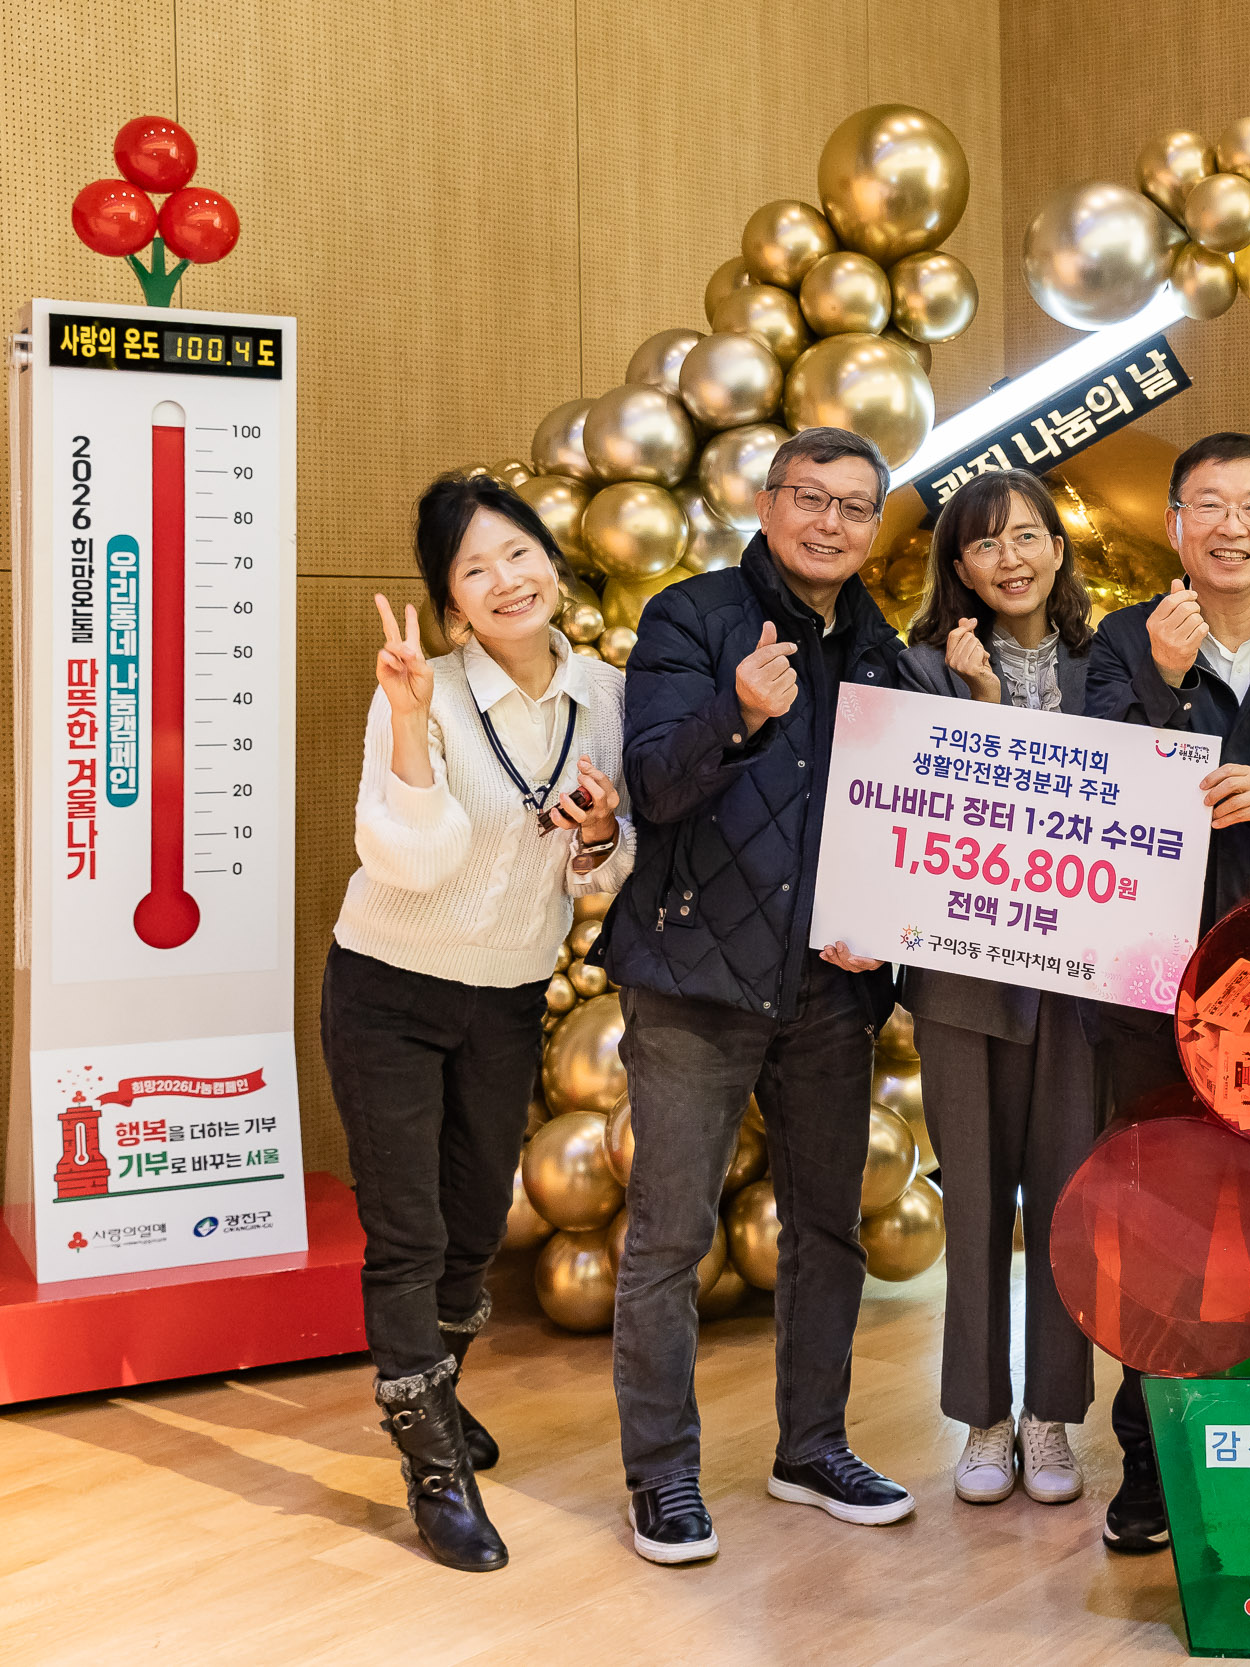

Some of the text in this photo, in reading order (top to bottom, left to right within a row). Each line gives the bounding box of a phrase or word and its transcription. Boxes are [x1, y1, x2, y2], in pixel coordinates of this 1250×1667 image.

[60, 324, 275, 367] 사랑의 온도 100.4 도
[1011, 374, 1134, 465] 나눔의
[1125, 349, 1177, 400] 날
[232, 425, 261, 439] 100
[233, 467, 253, 480] 90
[233, 512, 253, 525] 80
[71, 435, 94, 643] 2026 희망온돌
[233, 556, 253, 570] 70
[233, 601, 253, 614] 60
[233, 646, 253, 659] 50
[109, 551, 138, 795] 우리동네 나눔캠페인
[233, 692, 253, 705] 40
[233, 738, 253, 751] 30
[929, 726, 1110, 775] 구의3동 주민자치회
[67, 658, 99, 880] 따뜻한 겨울나기
[912, 751, 1121, 805] 생활안전환경분과 주관
[233, 784, 253, 797] 20
[234, 826, 252, 839] 10
[848, 778, 1184, 861] 아나바다 장터 1·2차 수익금
[232, 862, 243, 875] 0
[892, 825, 1139, 904] 1,536,800원
[947, 890, 1059, 936] 전액 기부
[928, 934, 1096, 981] 구의3동 주민자치회 일동
[115, 1116, 277, 1148] 행복을 더하는 기부
[118, 1148, 280, 1178] 기부로 바꾸는 서울
[224, 1210, 272, 1227] 광진구
